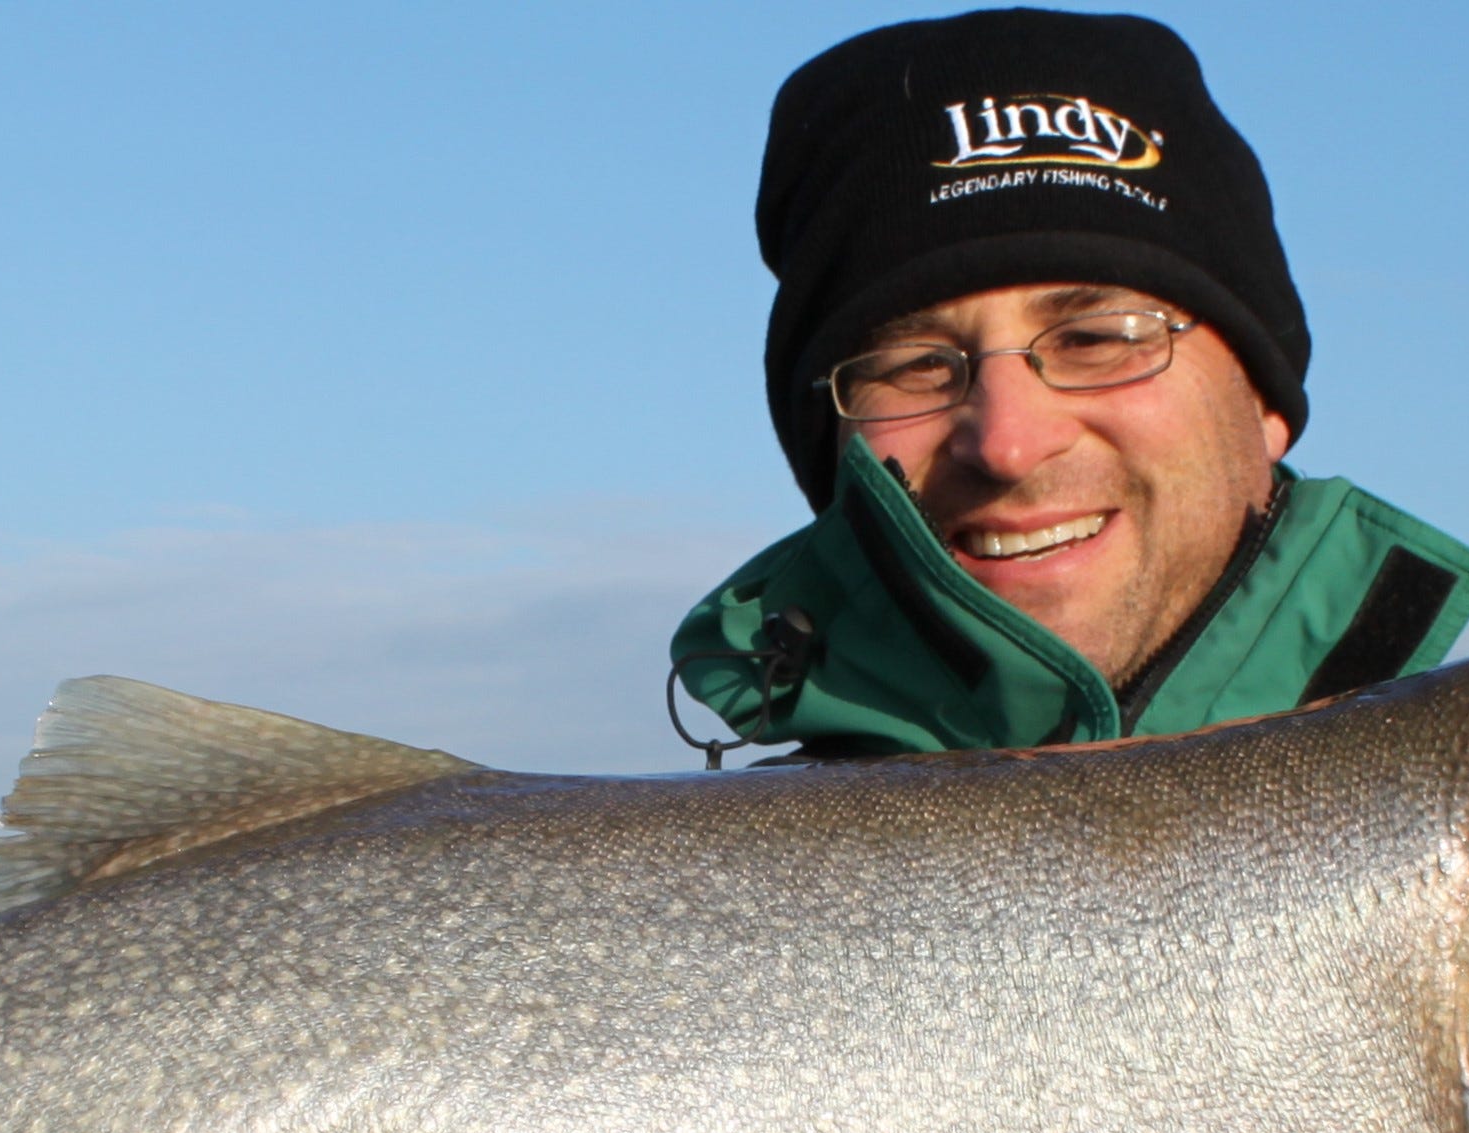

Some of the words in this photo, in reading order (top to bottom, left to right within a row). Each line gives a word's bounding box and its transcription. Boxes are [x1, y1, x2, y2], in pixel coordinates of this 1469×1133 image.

[944, 97, 1131, 165] Lindy
[930, 169, 1038, 204] LEGENDARY
[1042, 169, 1110, 191] FISHING
